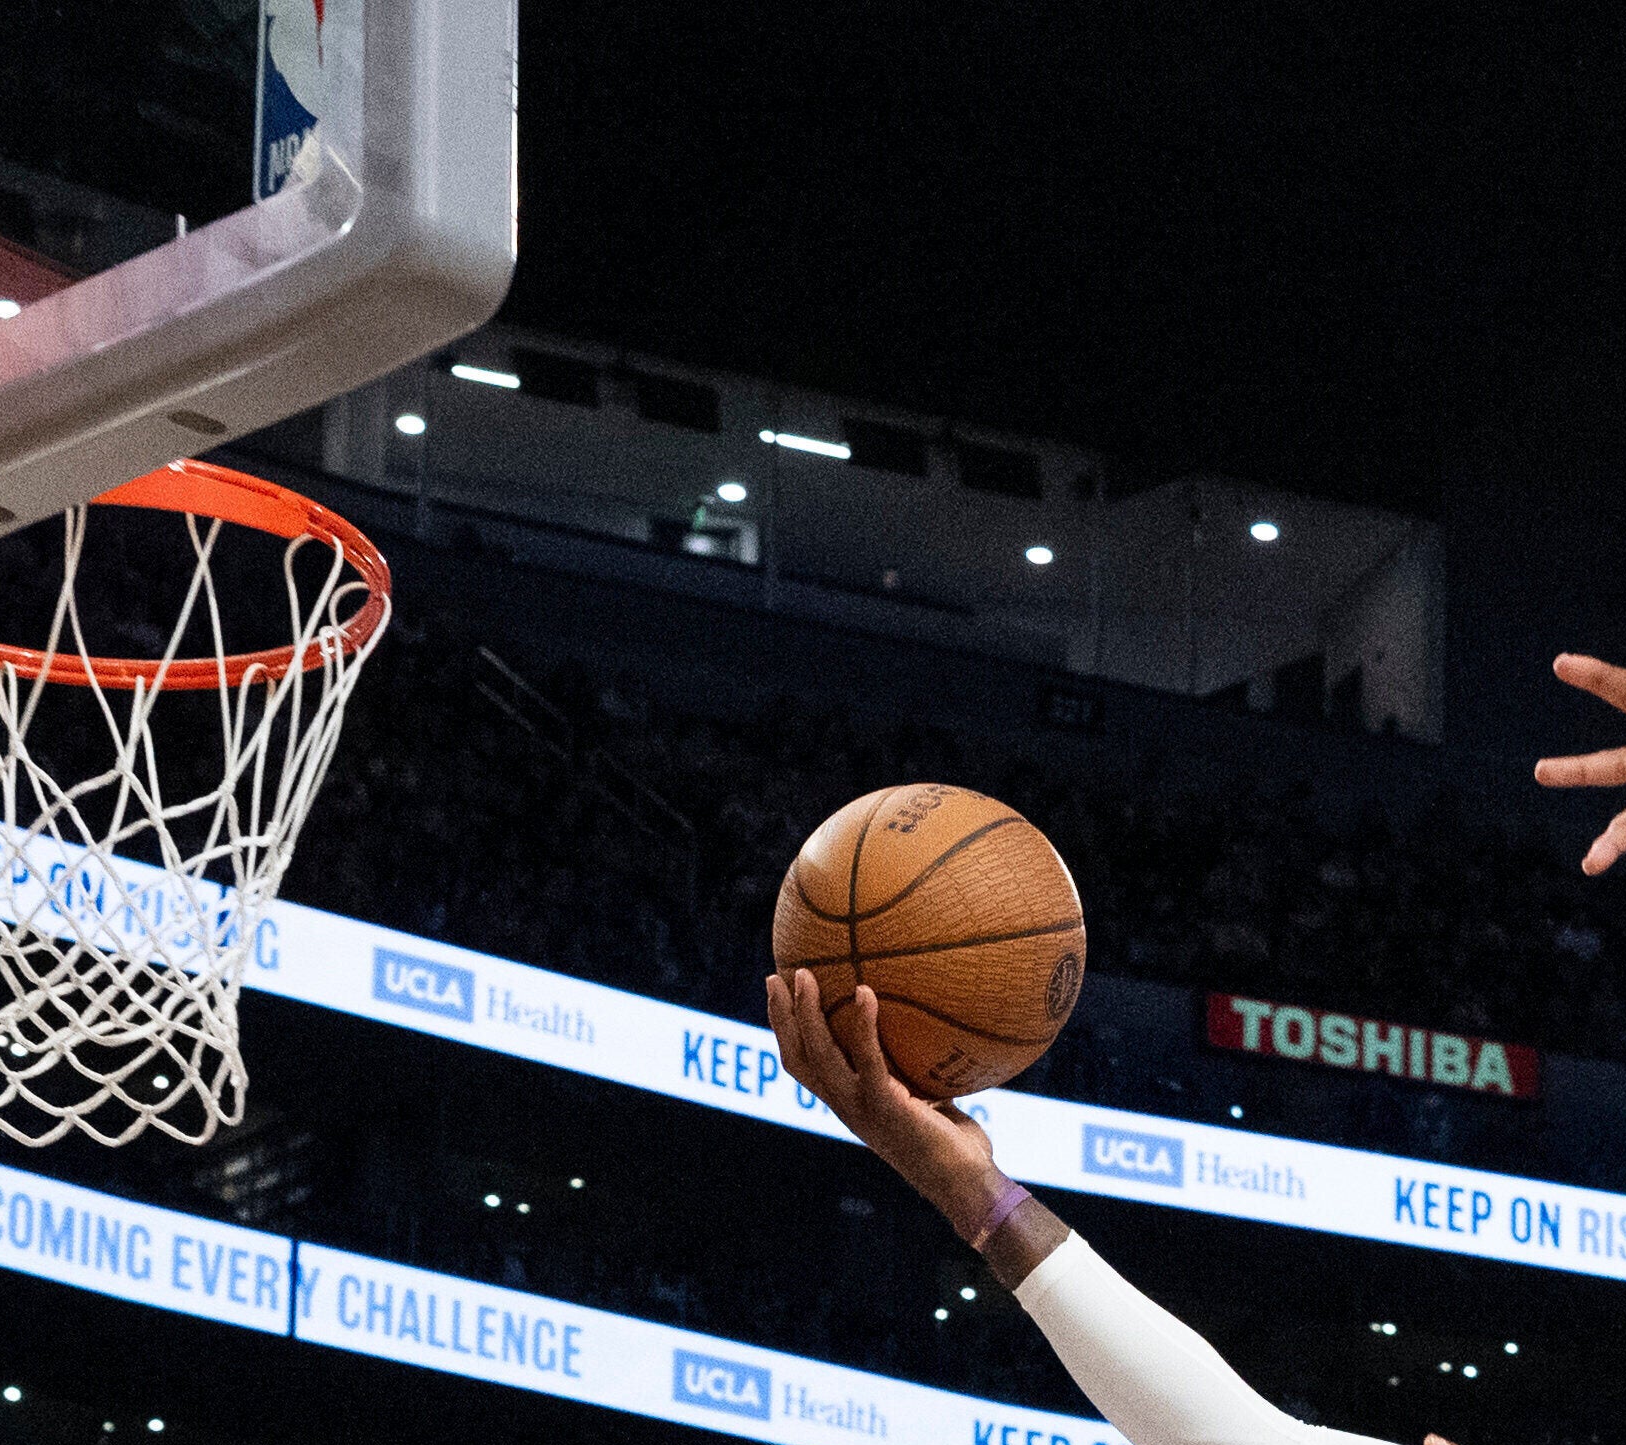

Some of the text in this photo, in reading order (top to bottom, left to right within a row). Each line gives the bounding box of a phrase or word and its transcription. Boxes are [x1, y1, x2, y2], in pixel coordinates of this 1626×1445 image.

[384, 960, 597, 1045] UCLA Health
[682, 1029, 777, 1098] KEEP
[1230, 998, 1516, 1096] TOSHIBA
[1095, 1138, 1307, 1199] UCLA Health
[1394, 1176, 1493, 1236] KEEP
[1509, 1196, 1561, 1250] ON
[171, 1234, 317, 1319] EVERY
[337, 1274, 582, 1379] CHALLENGE
[685, 1361, 888, 1438] UCLA Health
